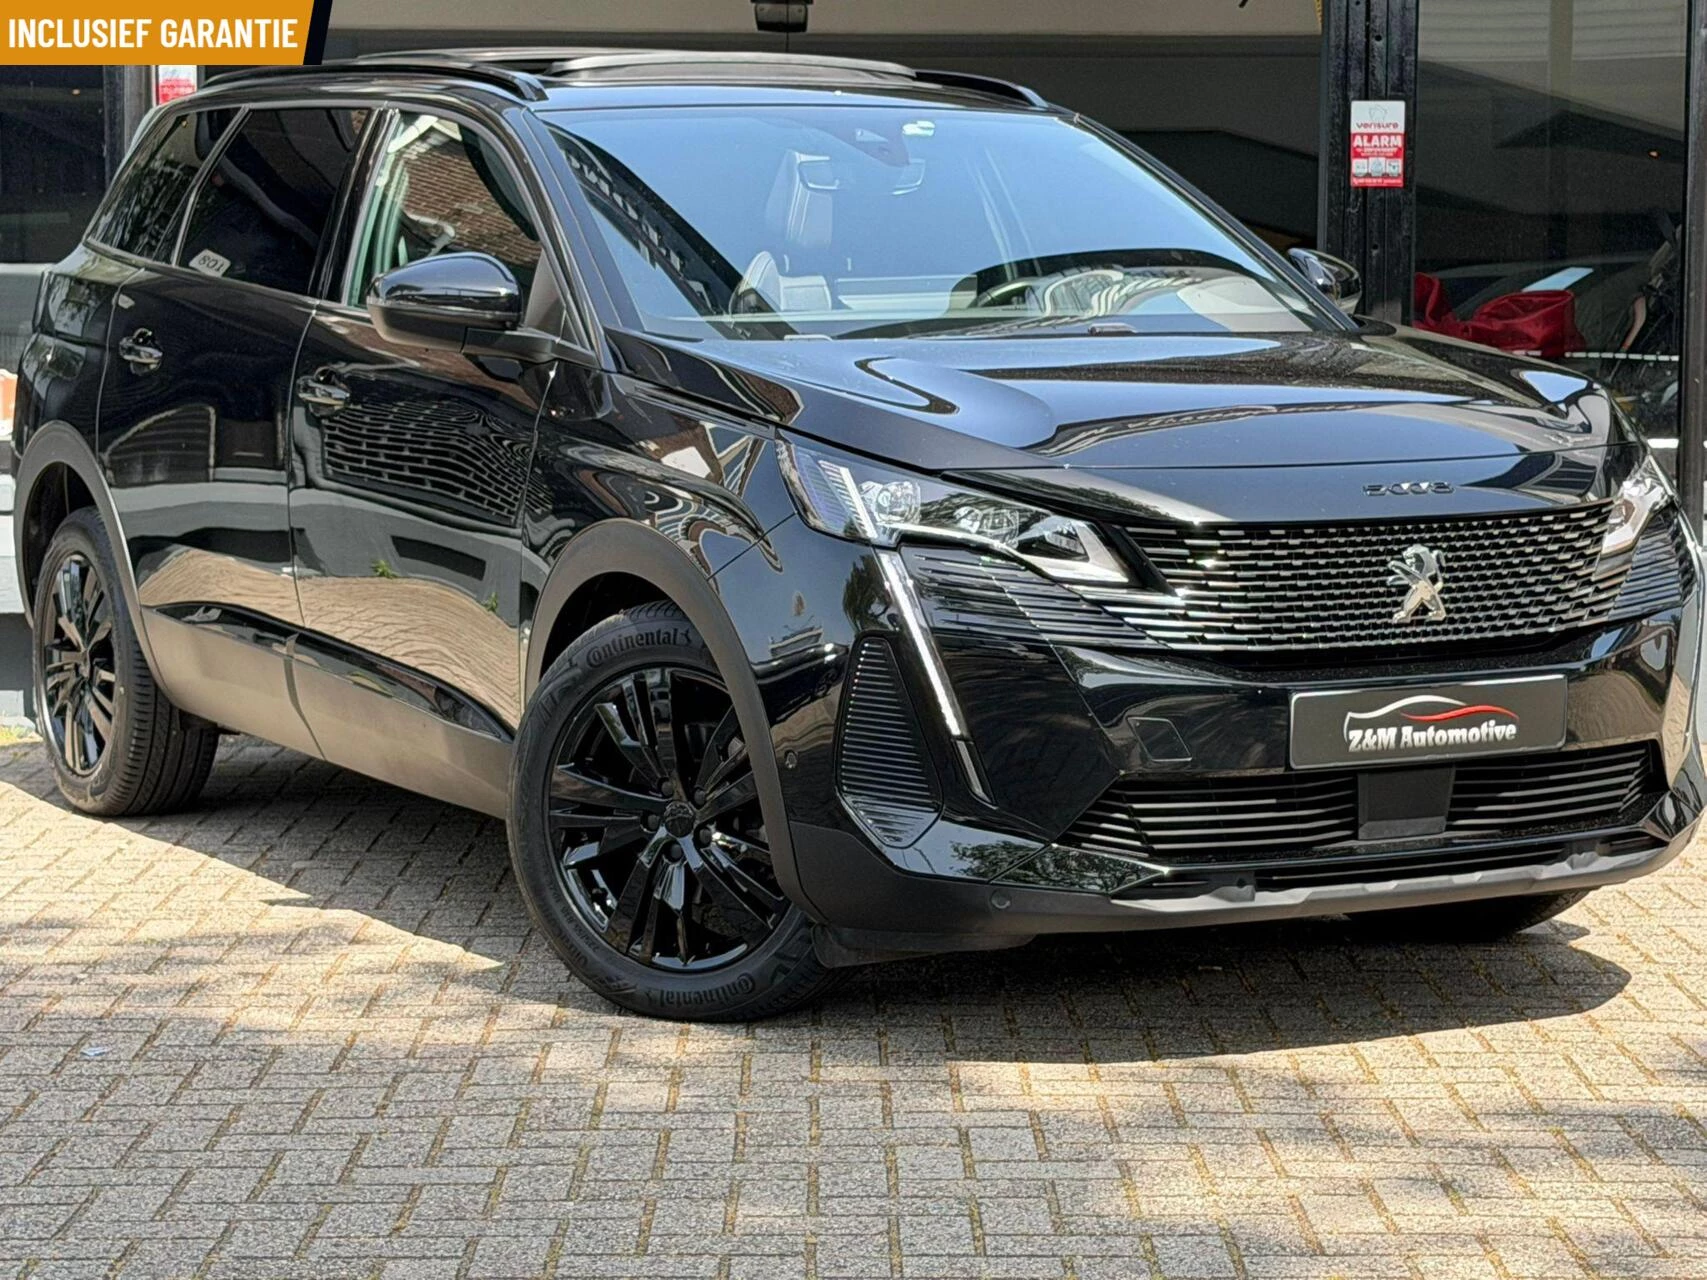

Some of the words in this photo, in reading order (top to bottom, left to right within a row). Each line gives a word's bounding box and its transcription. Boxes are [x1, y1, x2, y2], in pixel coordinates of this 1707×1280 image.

[1353, 135, 1402, 148] ALARM
[586, 627, 679, 669] Continental
[1349, 727, 1396, 752] Z&M
[1400, 719, 1517, 749] Automotive
[659, 972, 756, 1009] Continental
